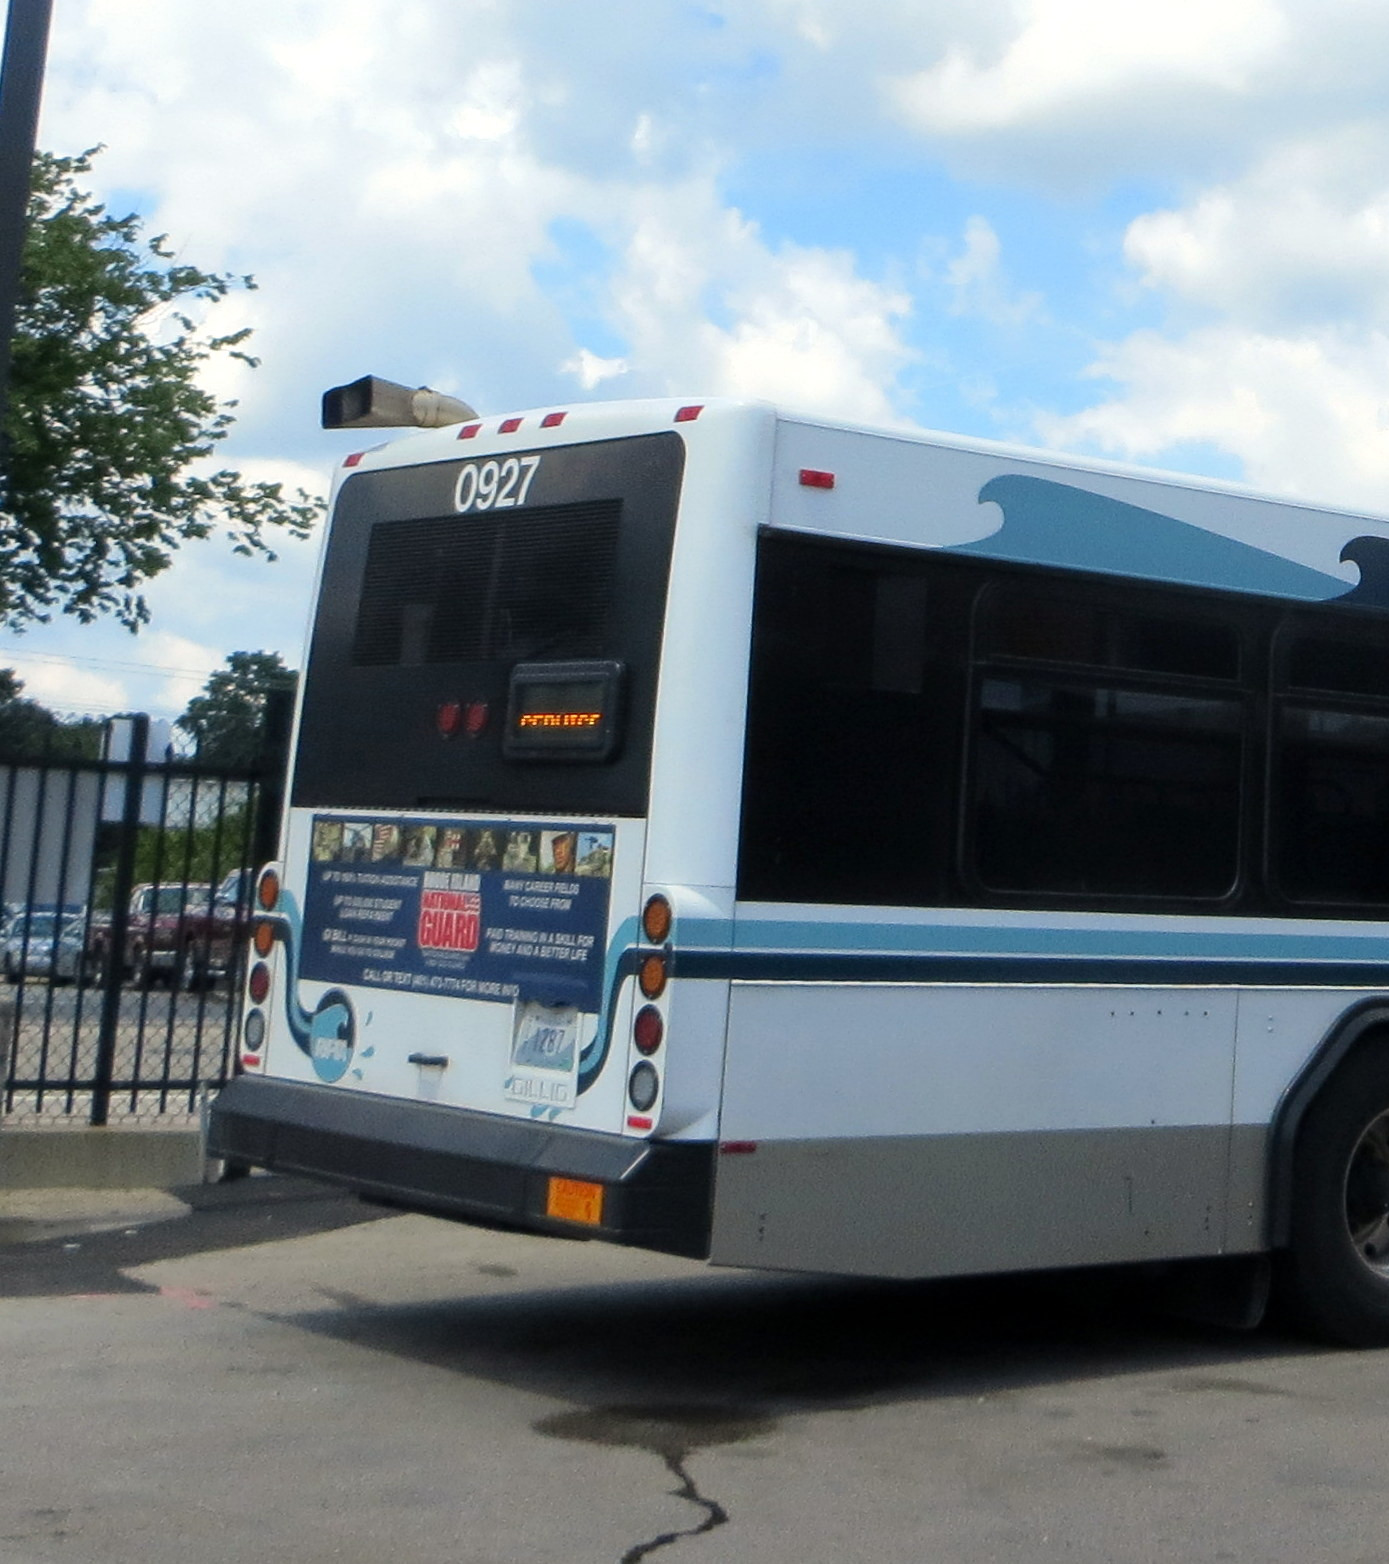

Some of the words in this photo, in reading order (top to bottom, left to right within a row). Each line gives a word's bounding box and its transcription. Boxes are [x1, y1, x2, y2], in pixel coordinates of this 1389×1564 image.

[454, 455, 541, 512] 0927
[524, 881, 556, 894] CAREER
[553, 882, 580, 896] FIELDS
[509, 895, 521, 908] TO
[520, 896, 551, 910] CHOOSE
[550, 898, 573, 912] FROM
[420, 909, 479, 950] GUARD
[554, 933, 577, 947] SKILL
[576, 935, 595, 949] FOR
[516, 943, 534, 957] AND
[533, 945, 541, 957] A
[540, 945, 571, 960] BETTER
[570, 948, 589, 962] LIFE
[511, 1077, 568, 1102] GILLIG
